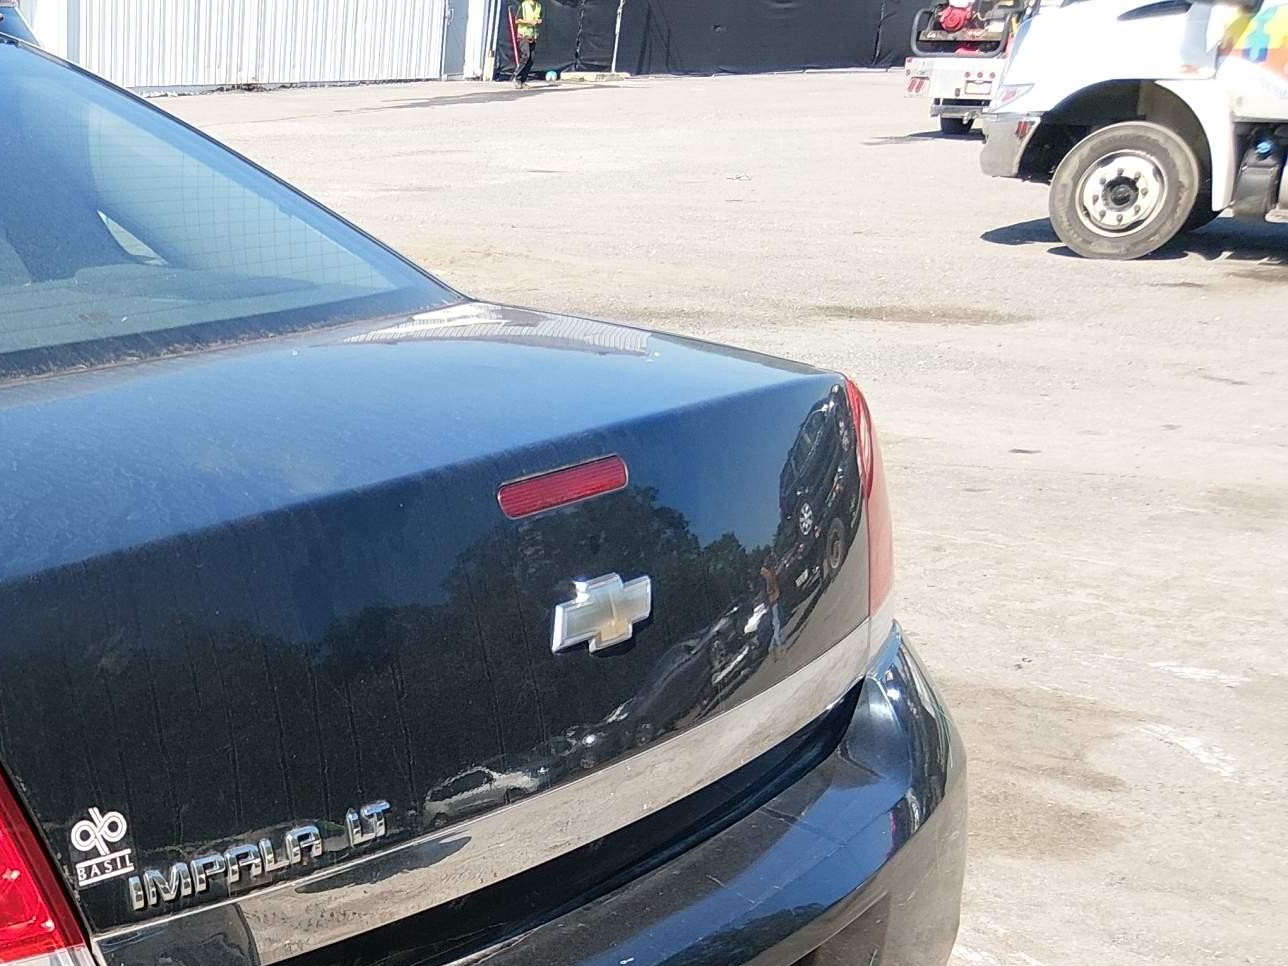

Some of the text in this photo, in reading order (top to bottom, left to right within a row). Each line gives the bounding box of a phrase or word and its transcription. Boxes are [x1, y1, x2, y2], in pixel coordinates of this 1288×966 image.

[76, 854, 134, 881] BASIL
[128, 800, 391, 911] IMPALA LT
